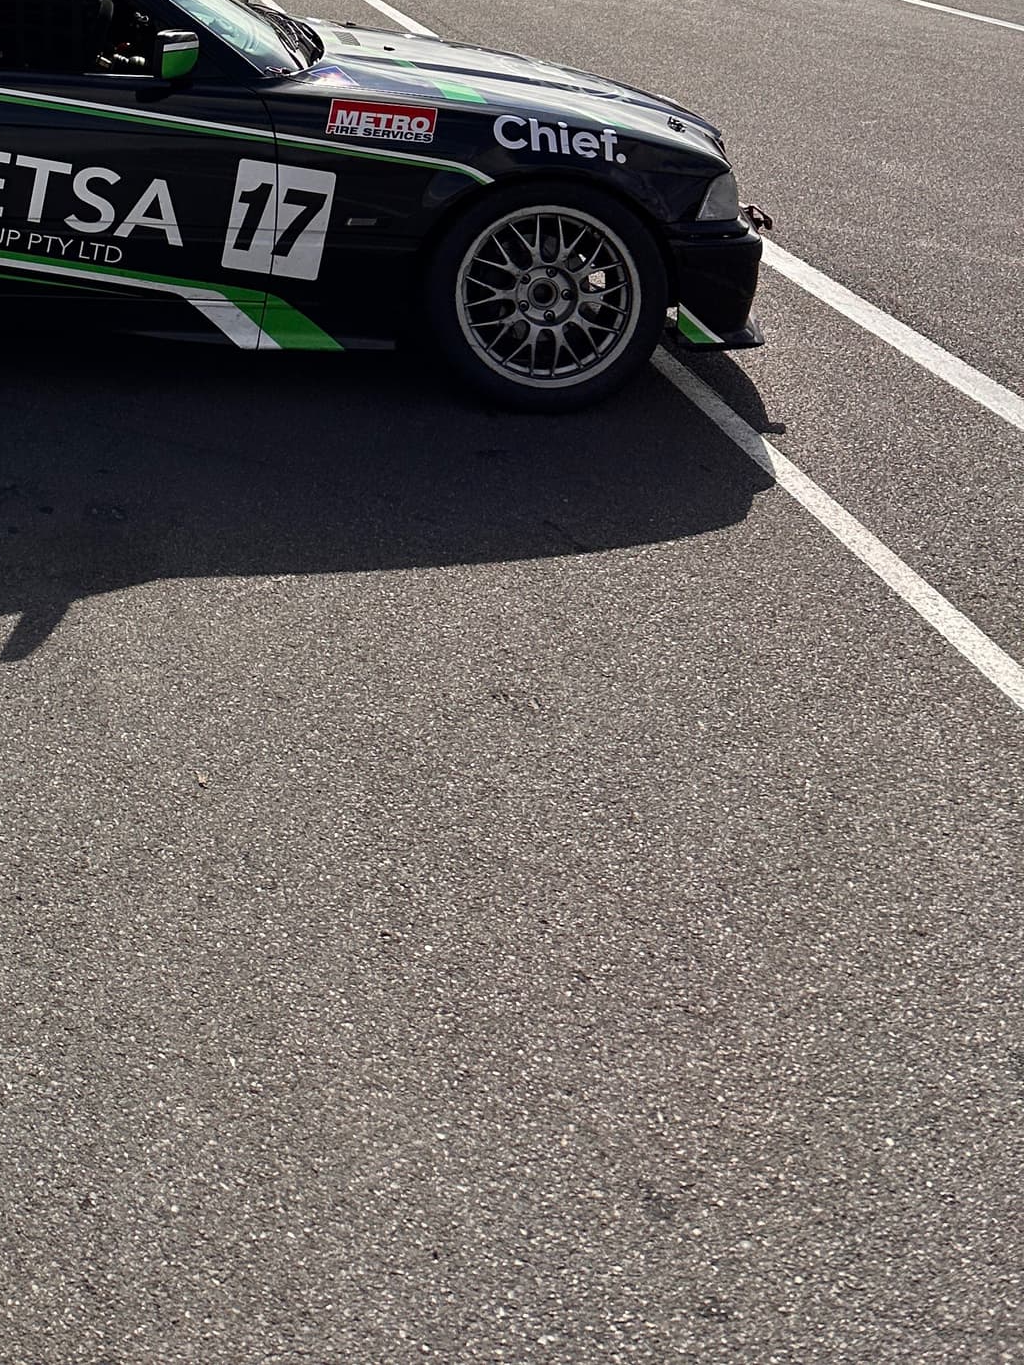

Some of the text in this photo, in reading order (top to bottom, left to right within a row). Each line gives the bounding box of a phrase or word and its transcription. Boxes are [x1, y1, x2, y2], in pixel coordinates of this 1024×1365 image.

[326, 124, 433, 143] FIRE SERVICES
[336, 109, 431, 133] METRO
[492, 114, 627, 164] Chief.
[232, 182, 328, 258] 17
[27, 234, 74, 256] PTY
[78, 241, 123, 264] LTD
